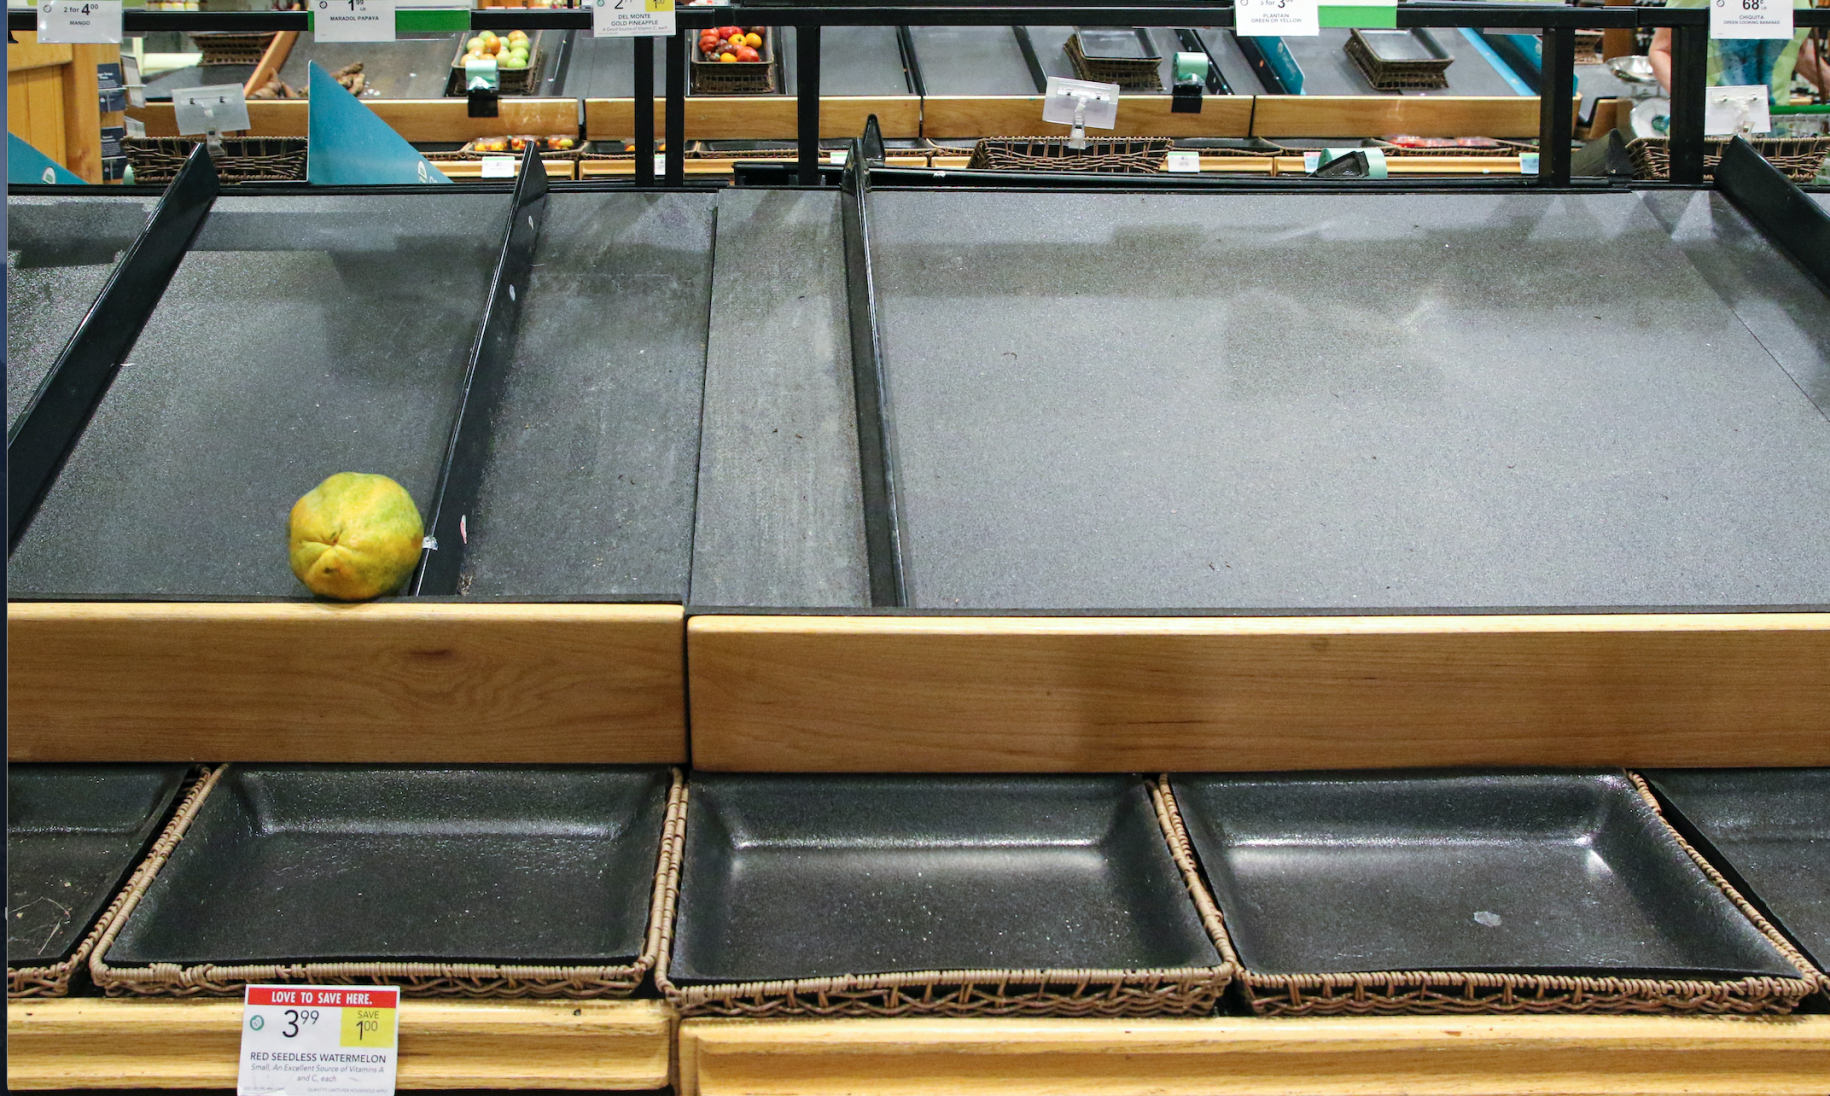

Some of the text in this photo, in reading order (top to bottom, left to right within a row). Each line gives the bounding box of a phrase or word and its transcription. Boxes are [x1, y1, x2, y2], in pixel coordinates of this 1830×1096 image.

[271, 991, 372, 1004] LOVE TO SAVE HERE.
[357, 1011, 379, 1019] SAVE
[250, 1052, 386, 1063] RED SEEDLESS WATERMELON
[251, 1064, 271, 1072] Small,
[284, 1064, 314, 1072] Excellent
